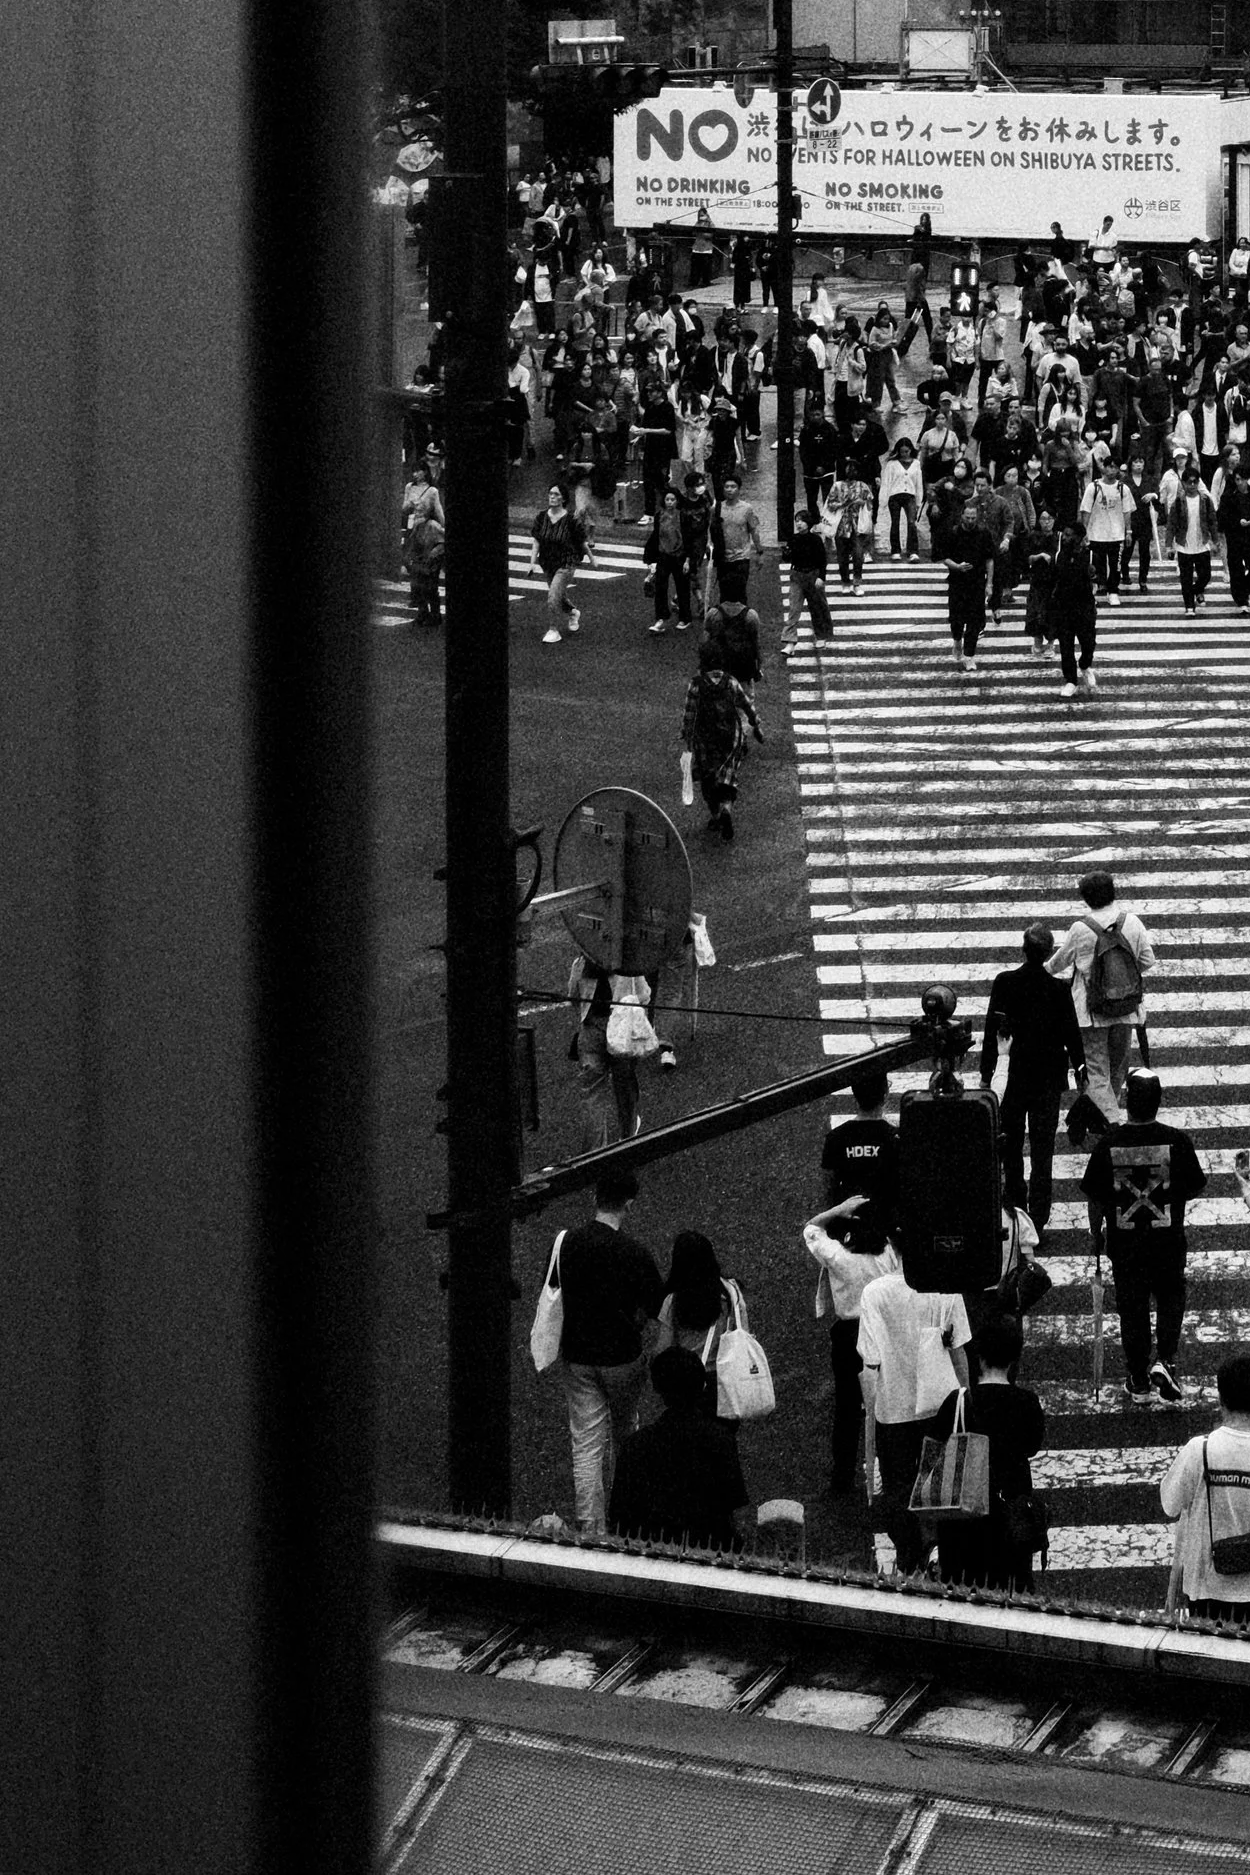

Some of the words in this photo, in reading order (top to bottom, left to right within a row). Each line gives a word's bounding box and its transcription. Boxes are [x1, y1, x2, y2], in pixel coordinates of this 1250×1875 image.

[636, 108, 738, 162] NO
[747, 147, 772, 163] NO
[844, 149, 876, 166] FOR
[882, 149, 986, 167] HALLOWEEN
[991, 151, 1015, 167] ON
[1020, 151, 1097, 171] SHIBUYA
[1102, 153, 1181, 173] STREETS.
[636, 176, 663, 193] NO
[667, 177, 750, 195] DRINKING
[825, 181, 852, 198] NO
[857, 182, 944, 200] SMOKING
[636, 196, 652, 206] ON
[655, 197, 673, 207] THE
[825, 200, 841, 211] ON
[844, 201, 863, 212] THE
[867, 202, 905, 213] STREET.
[1145, 199, 1181, 212] 渋谷区
[1208, 1473, 1240, 1483] uman
